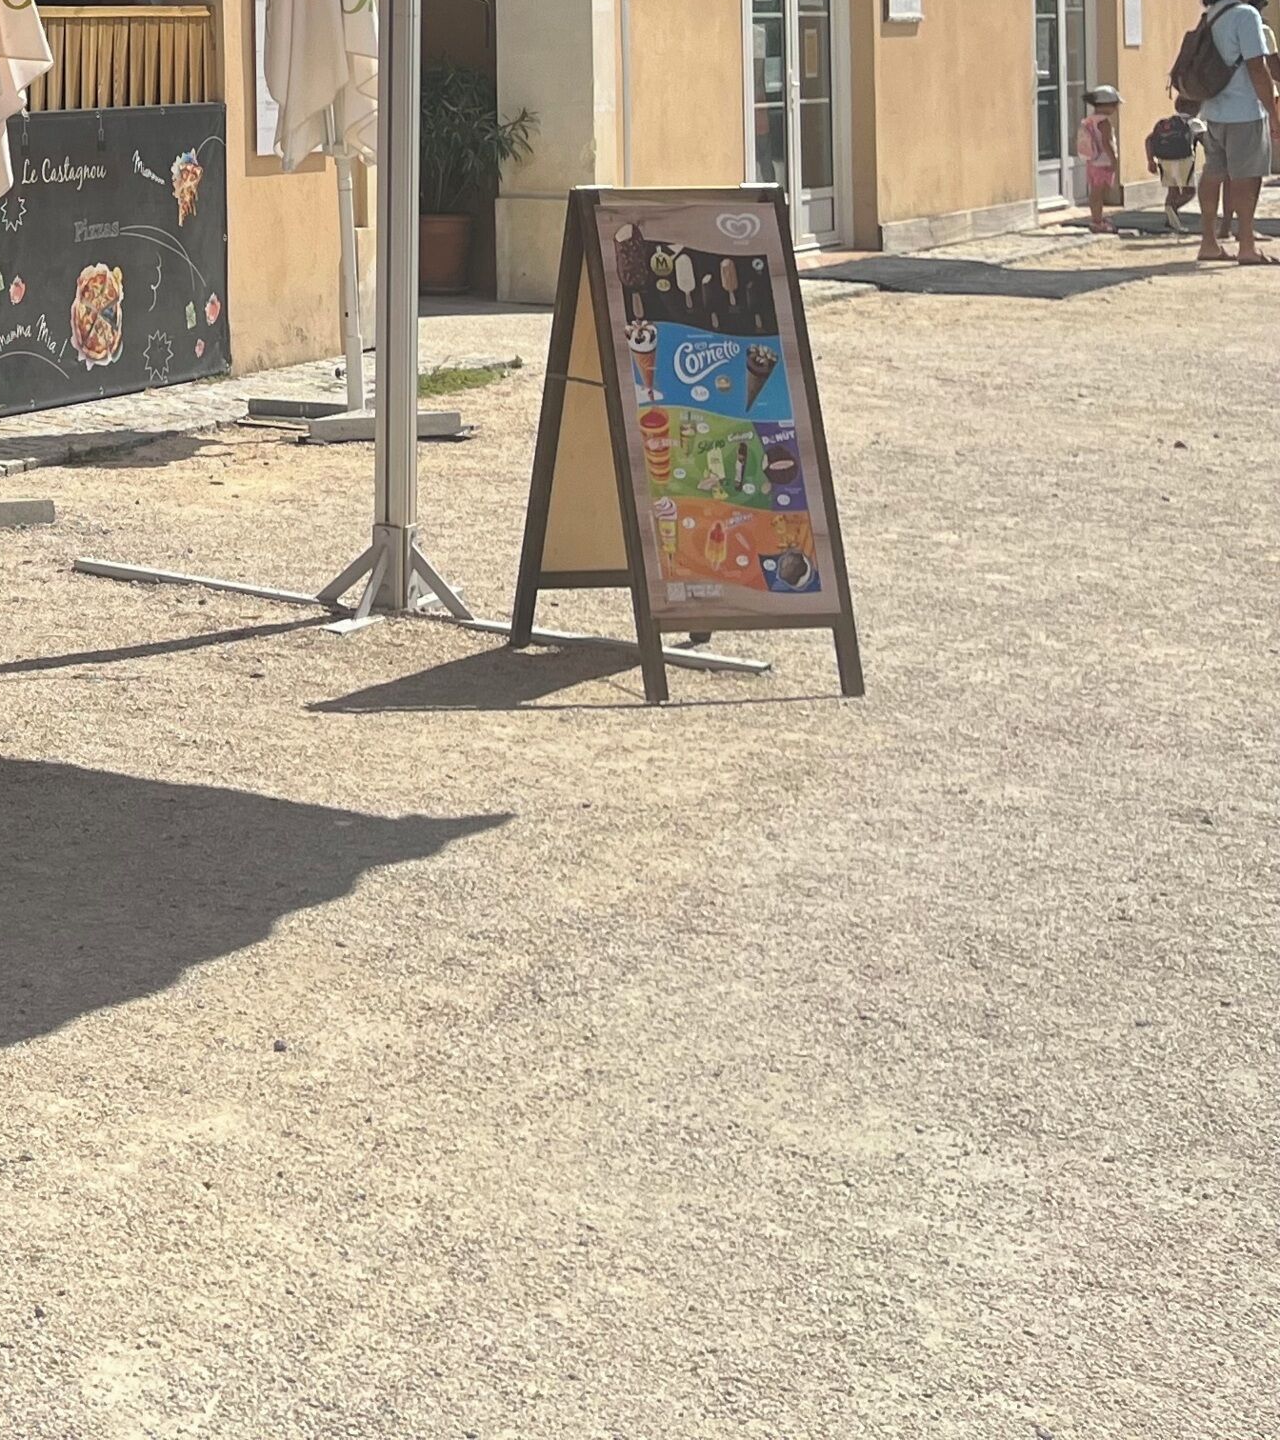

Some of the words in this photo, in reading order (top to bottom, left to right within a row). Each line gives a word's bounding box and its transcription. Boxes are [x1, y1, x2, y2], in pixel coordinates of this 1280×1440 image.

[21, 159, 39, 185] Le
[41, 156, 107, 190] Castagnou
[73, 218, 120, 243] Pizzas
[36, 313, 57, 354] Mia
[673, 340, 740, 385] Cornetto
